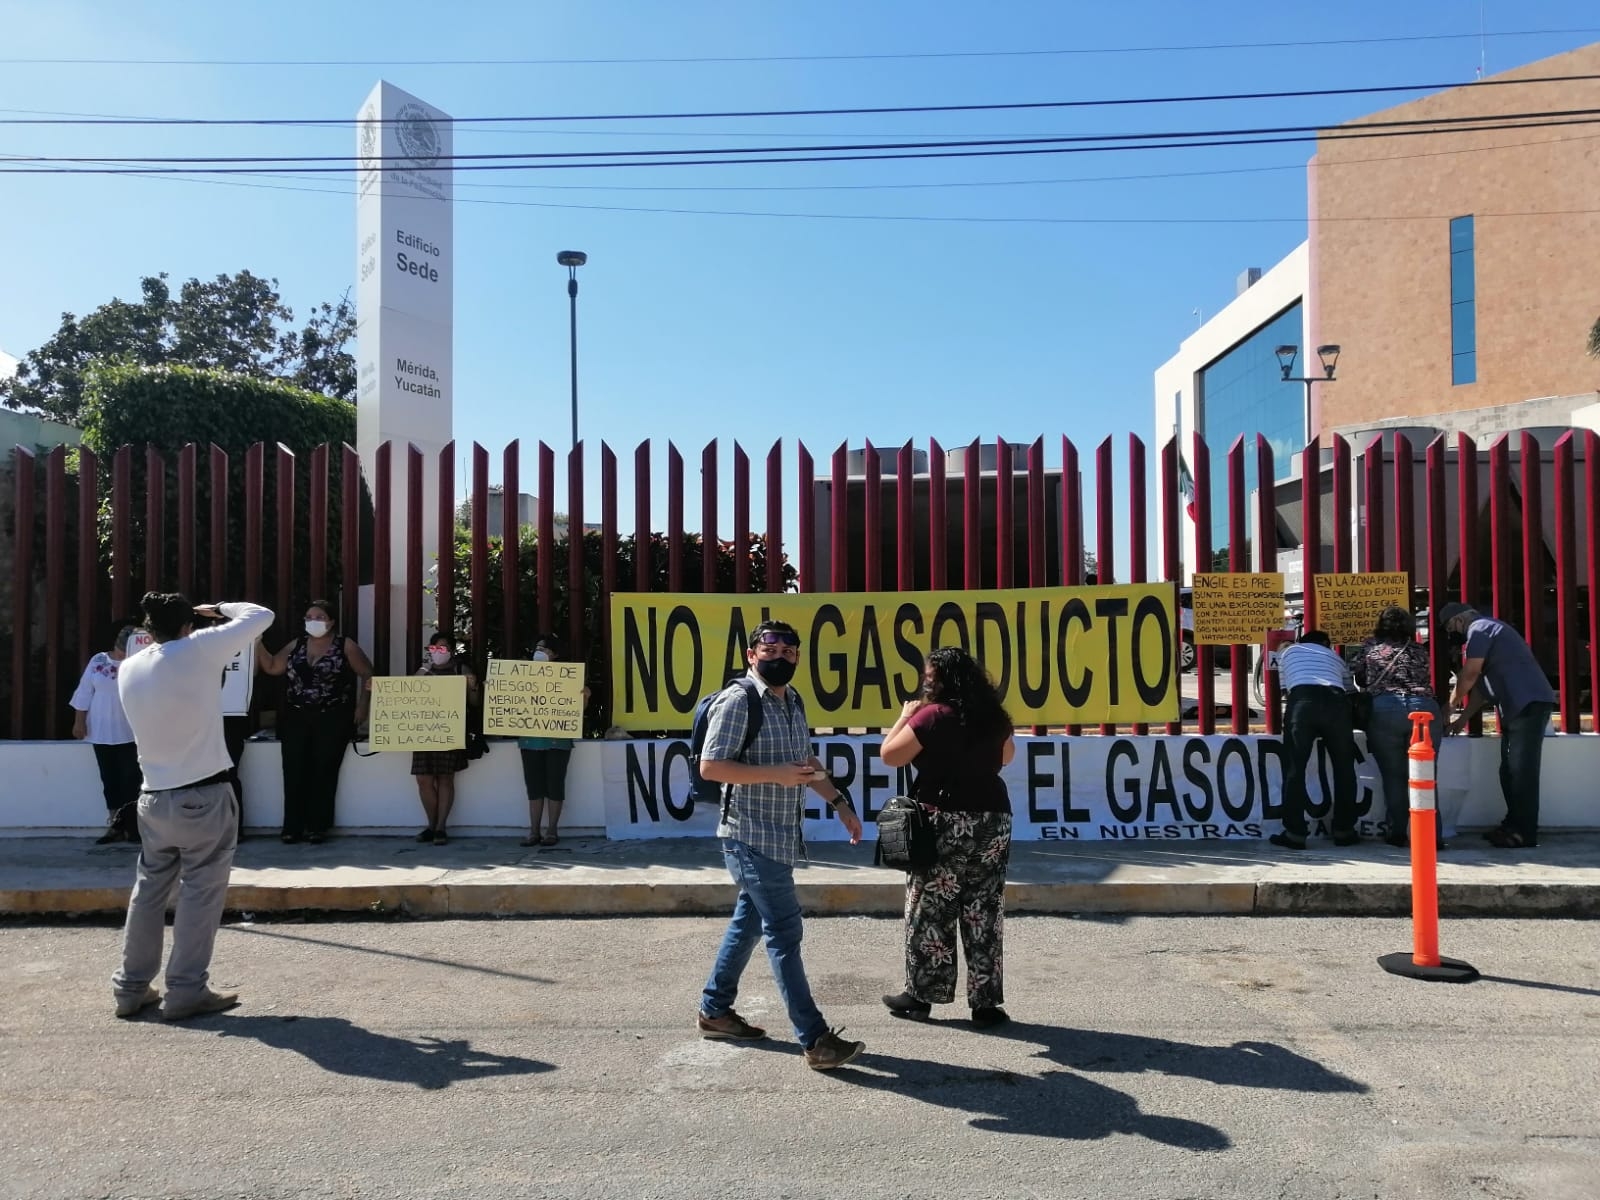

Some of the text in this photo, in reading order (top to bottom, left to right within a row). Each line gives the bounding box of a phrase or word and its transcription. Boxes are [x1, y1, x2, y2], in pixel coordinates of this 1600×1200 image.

[396, 229, 440, 258] Edificio
[396, 252, 439, 283] Sede
[396, 357, 439, 383] Mérida,
[395, 375, 441, 399] Yucatán
[1193, 575, 1278, 589] ENGIE ES PRE-
[1316, 577, 1333, 589] EN
[1337, 577, 1351, 588] LA
[1351, 576, 1376, 586] ZONA
[1194, 591, 1285, 599] SUNTA RESPONSABLE
[1319, 590, 1332, 599] TE
[1333, 590, 1346, 599] DE
[1346, 590, 1357, 598] LA
[1374, 587, 1404, 597] EXISTE
[1195, 601, 1206, 609] DE
[1229, 601, 1280, 609] EXPLOSION
[1320, 601, 1334, 612] EL
[1334, 600, 1363, 611] RIESGO
[1365, 600, 1379, 609] DE
[1195, 610, 1210, 618] CON
[1219, 609, 1266, 617] FALLECIDOS
[1320, 612, 1332, 621] SE
[1241, 618, 1271, 626] FUGAS
[1272, 617, 1284, 625] DE
[1196, 625, 1211, 634] GAS
[1211, 625, 1247, 634] NATURAL
[1250, 625, 1264, 633] EN
[135, 635, 151, 645] NO
[622, 604, 703, 715] NO
[489, 662, 577, 679] EL ATLAS DE
[376, 679, 431, 693] VECINOS
[487, 679, 563, 693] RIESGOS DE
[376, 696, 441, 707] REPORTAN
[488, 695, 577, 706] MERIDA NO CON-
[375, 709, 459, 720] LA EXISTENCIA
[489, 706, 580, 718] TEMPLA LOS RIESGOS
[375, 722, 451, 733] DE CUEVAS
[488, 717, 579, 732] DE SOCAVONES
[375, 735, 456, 745] EN LA CALLE
[626, 741, 695, 824] NO
[1028, 741, 1091, 824] EL
[1041, 826, 1079, 839] EN
[1099, 823, 1263, 840] NUESTRAS
